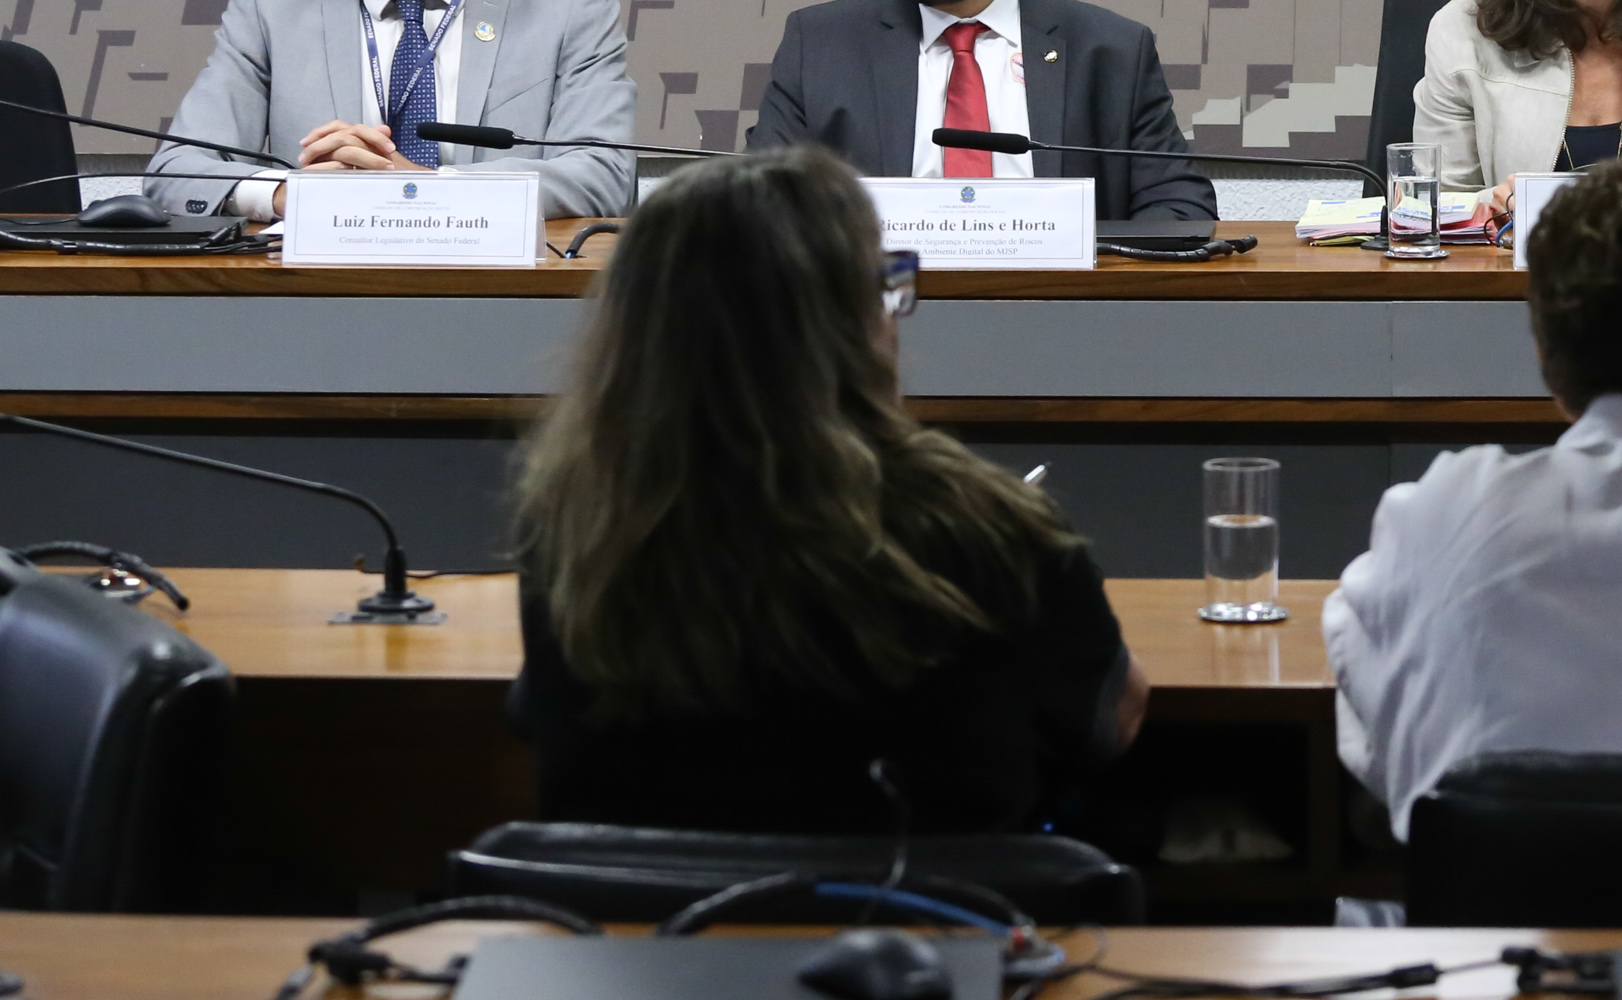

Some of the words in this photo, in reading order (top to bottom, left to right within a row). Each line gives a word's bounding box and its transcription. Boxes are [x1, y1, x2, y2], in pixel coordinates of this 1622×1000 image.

[428, 28, 444, 52] SENADO
[440, 4, 457, 29] FEDERAL
[372, 56, 381, 83] FEDERAL
[406, 66, 424, 92] FEDERAL
[376, 83, 384, 108] SENADO
[333, 215, 365, 228] Luiz
[370, 215, 441, 228] Fernando
[446, 216, 489, 229] Fauth
[939, 219, 957, 231] de
[962, 219, 994, 231] Lins
[999, 222, 1007, 231] e
[1012, 219, 1056, 231] Horta
[339, 236, 374, 244] Consultor
[375, 236, 414, 246] Legislativo
[415, 236, 425, 244] do
[426, 236, 453, 244] Senado
[453, 237, 480, 245] Federal
[924, 238, 962, 247] Segurança
[969, 238, 1007, 247] Prevenção
[958, 248, 984, 256] Digital
